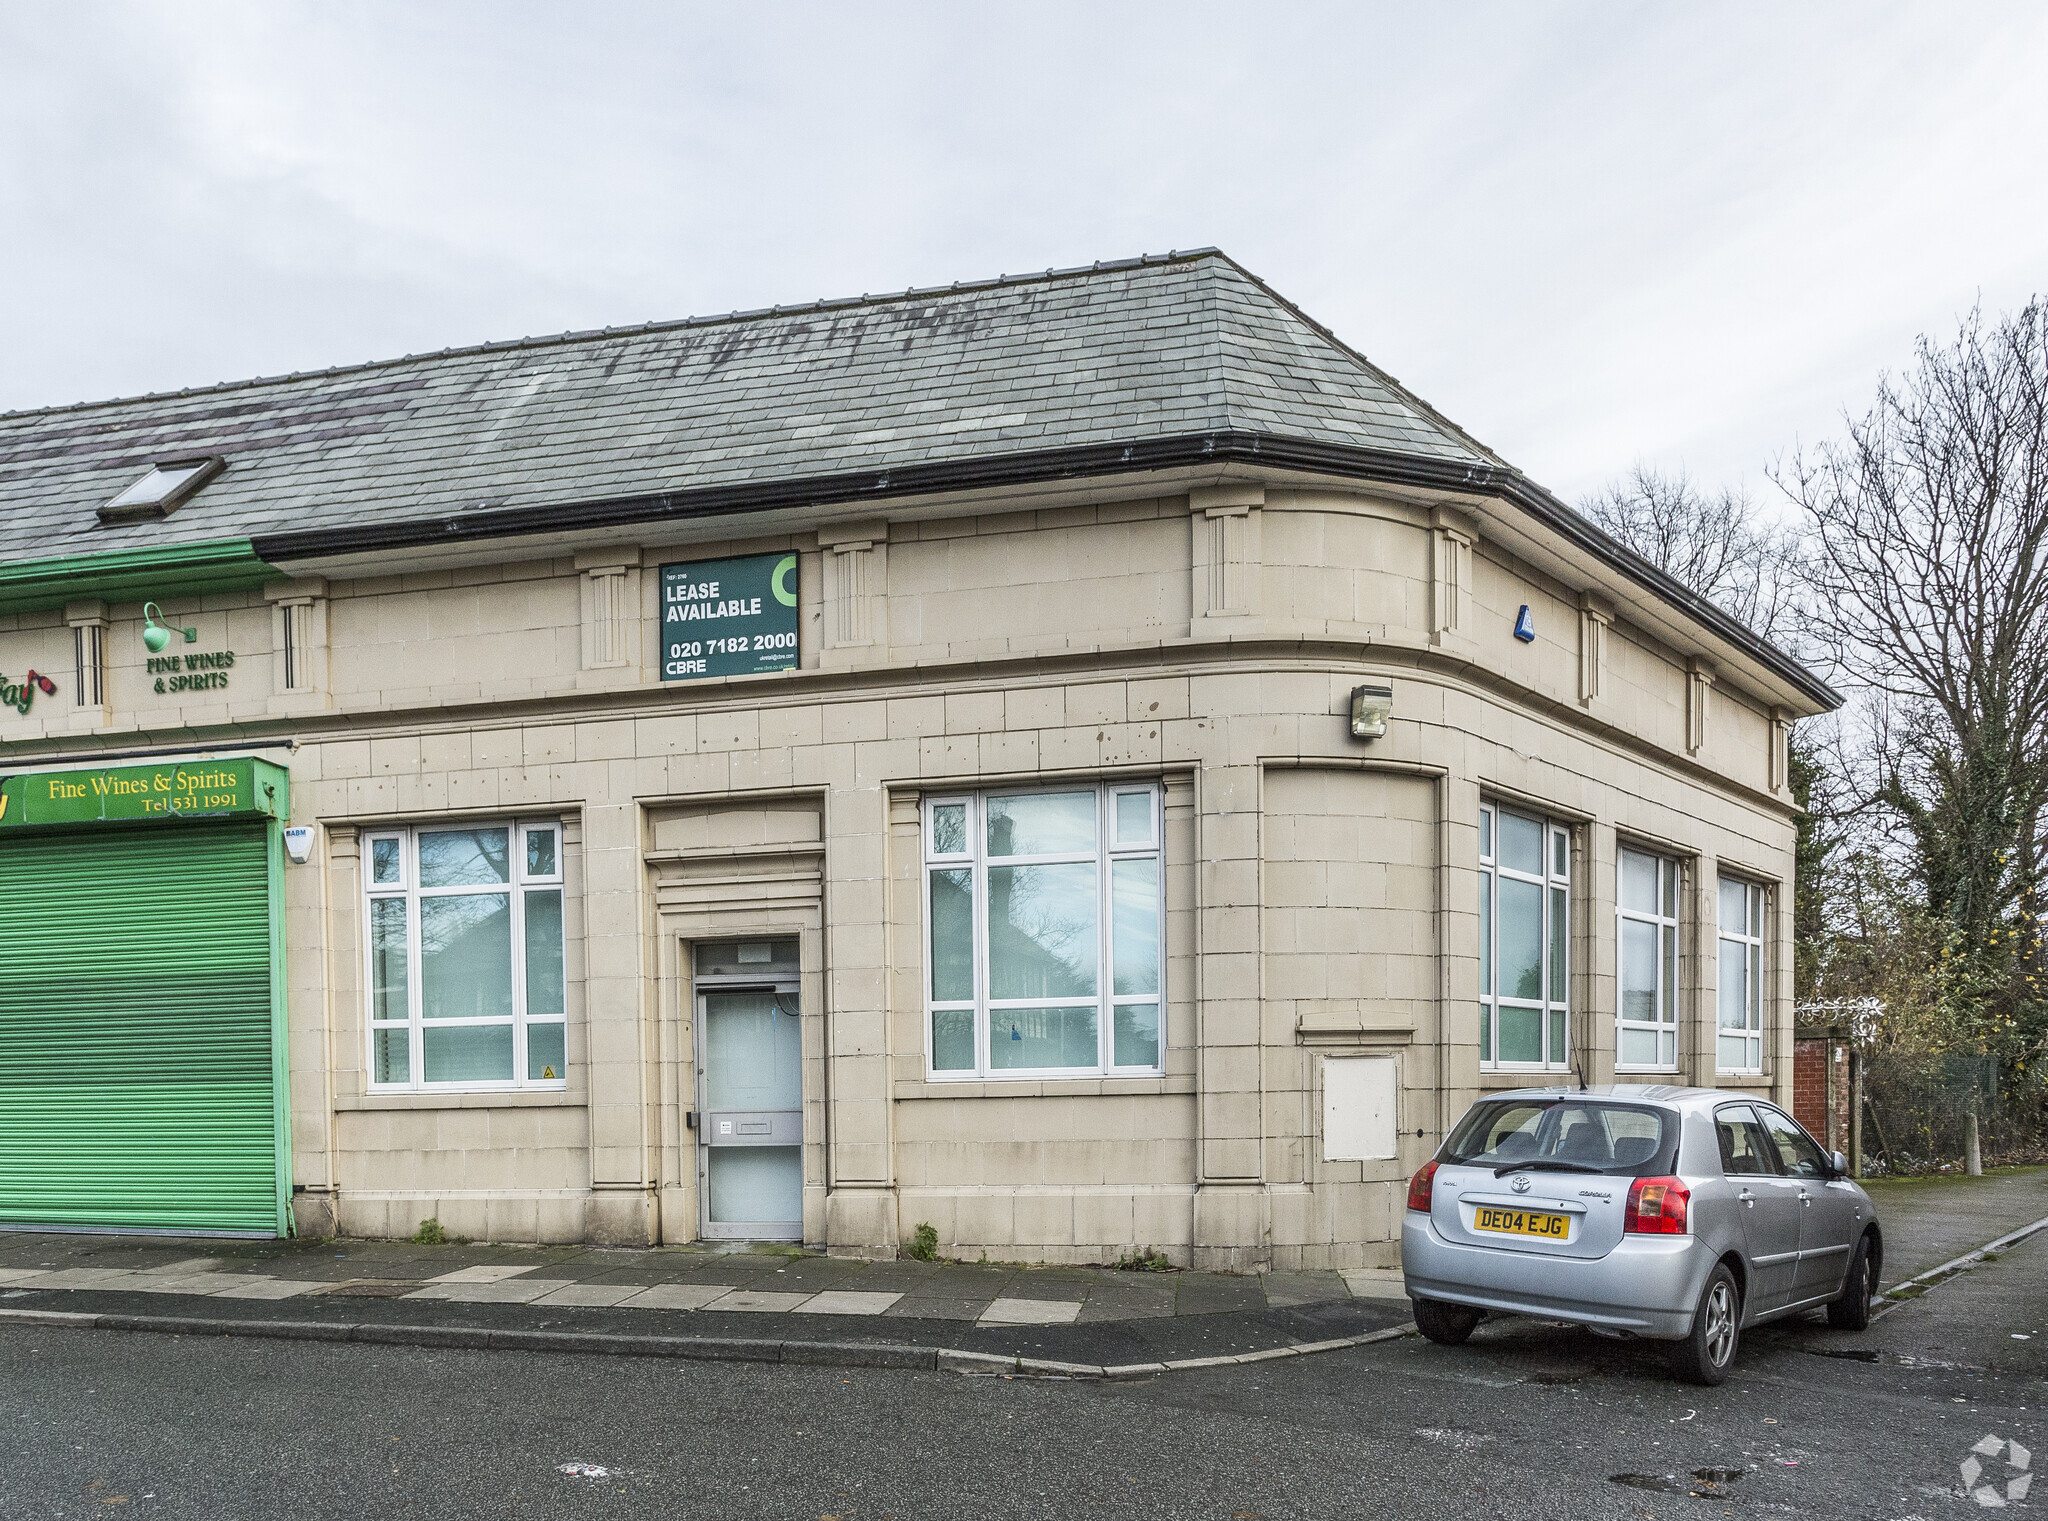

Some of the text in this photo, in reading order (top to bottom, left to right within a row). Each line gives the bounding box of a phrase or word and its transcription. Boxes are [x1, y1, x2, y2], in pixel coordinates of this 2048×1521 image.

[666, 581, 720, 602] LEASE
[666, 598, 762, 622] AVAILABLE
[670, 632, 796, 659] 020 7182 2000
[146, 650, 235, 674] FINE WINES
[666, 659, 707, 675] CBRE
[153, 671, 229, 694] & SPIRITS
[48, 769, 237, 800] Fine Wines & Spirits
[141, 793, 238, 813] Tel 531 1991
[290, 829, 307, 837] ABM
[1481, 1210, 1563, 1235] DE04 EJG
